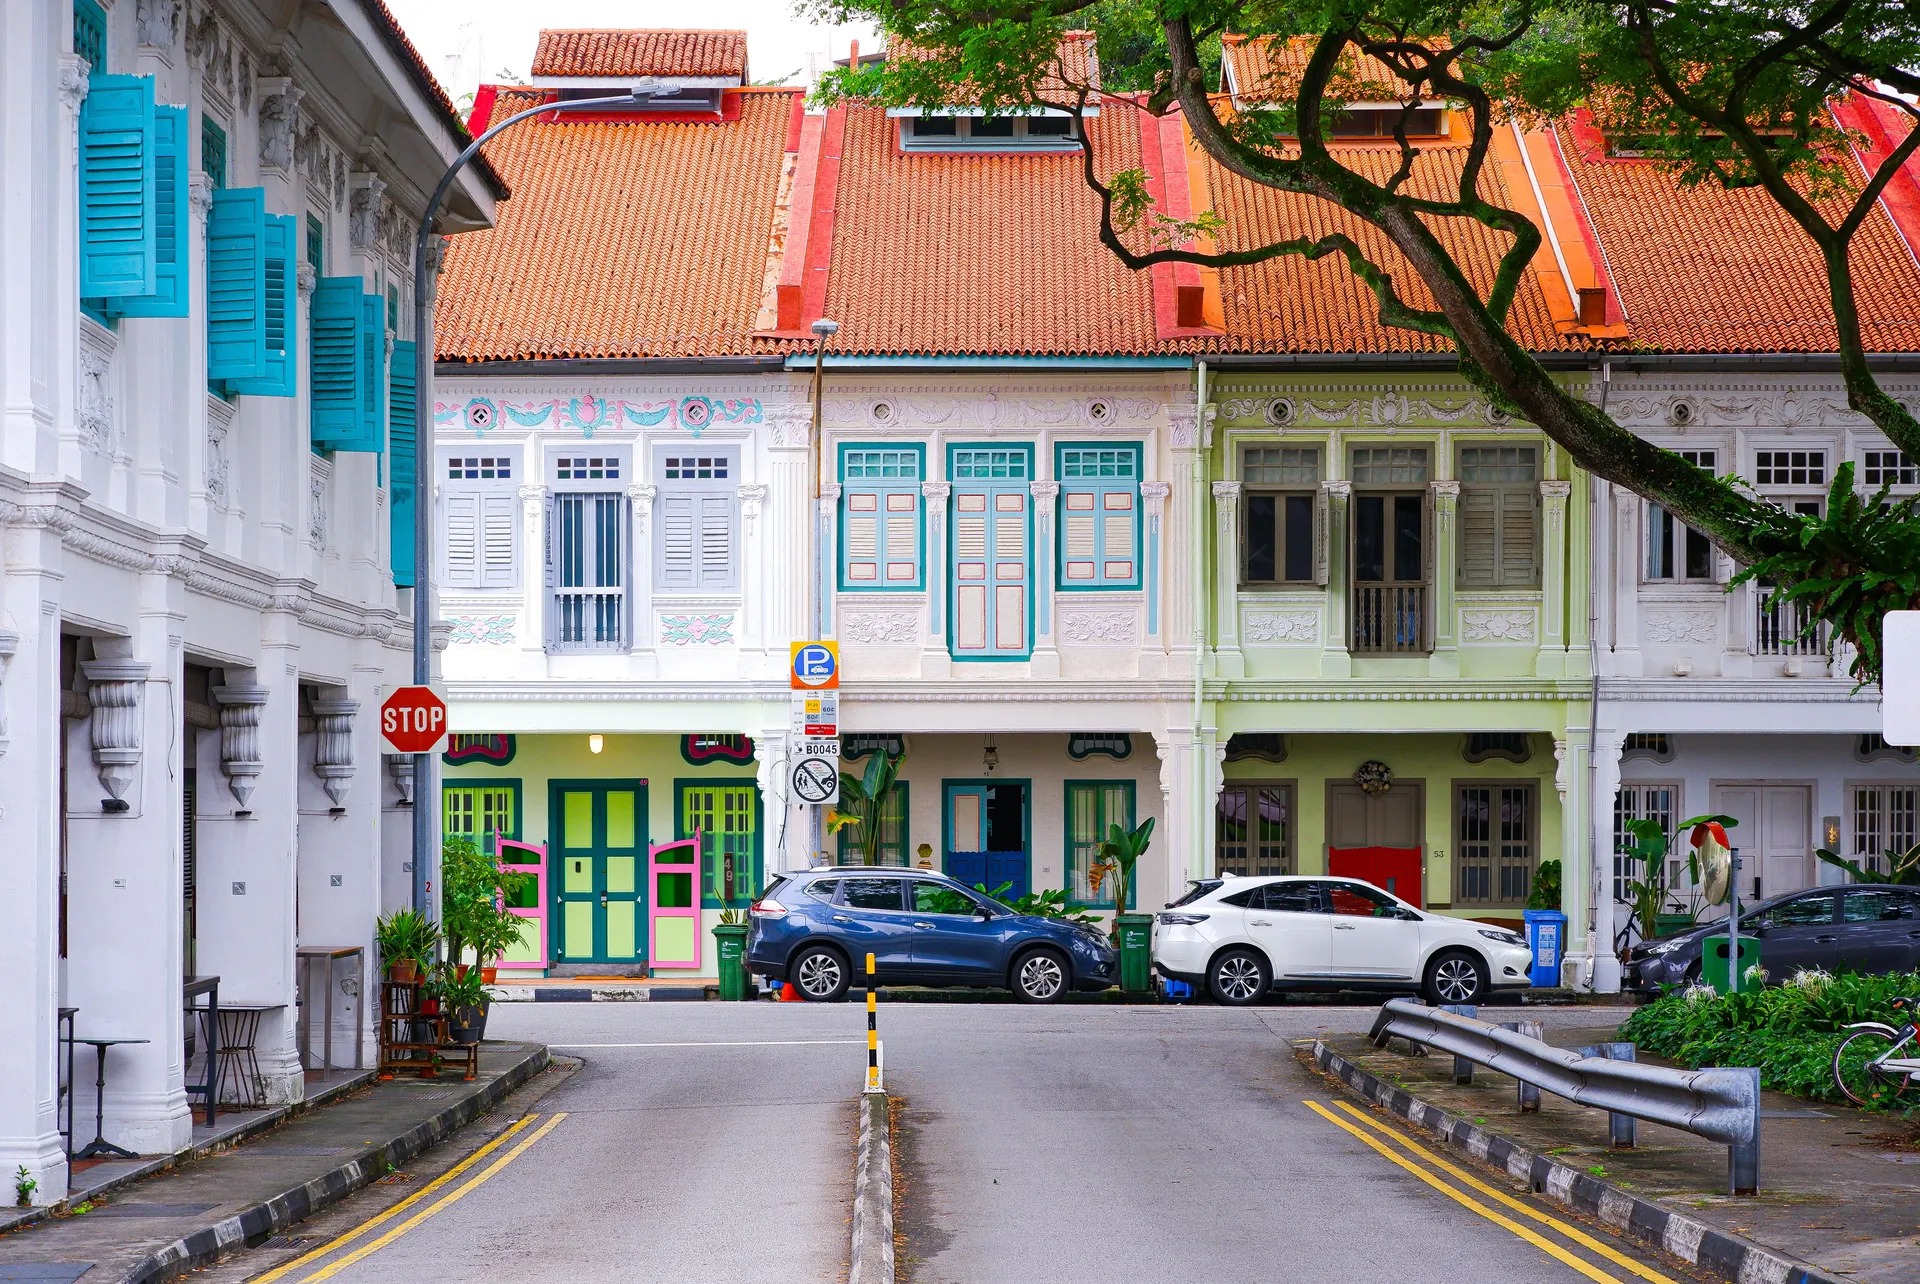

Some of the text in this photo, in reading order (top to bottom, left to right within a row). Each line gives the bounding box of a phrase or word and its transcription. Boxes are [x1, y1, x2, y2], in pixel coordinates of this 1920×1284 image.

[804, 648, 830, 675] P
[383, 706, 443, 733] STOP
[806, 744, 837, 755] B0045
[1434, 850, 1444, 858] 53
[425, 881, 431, 892] 2
